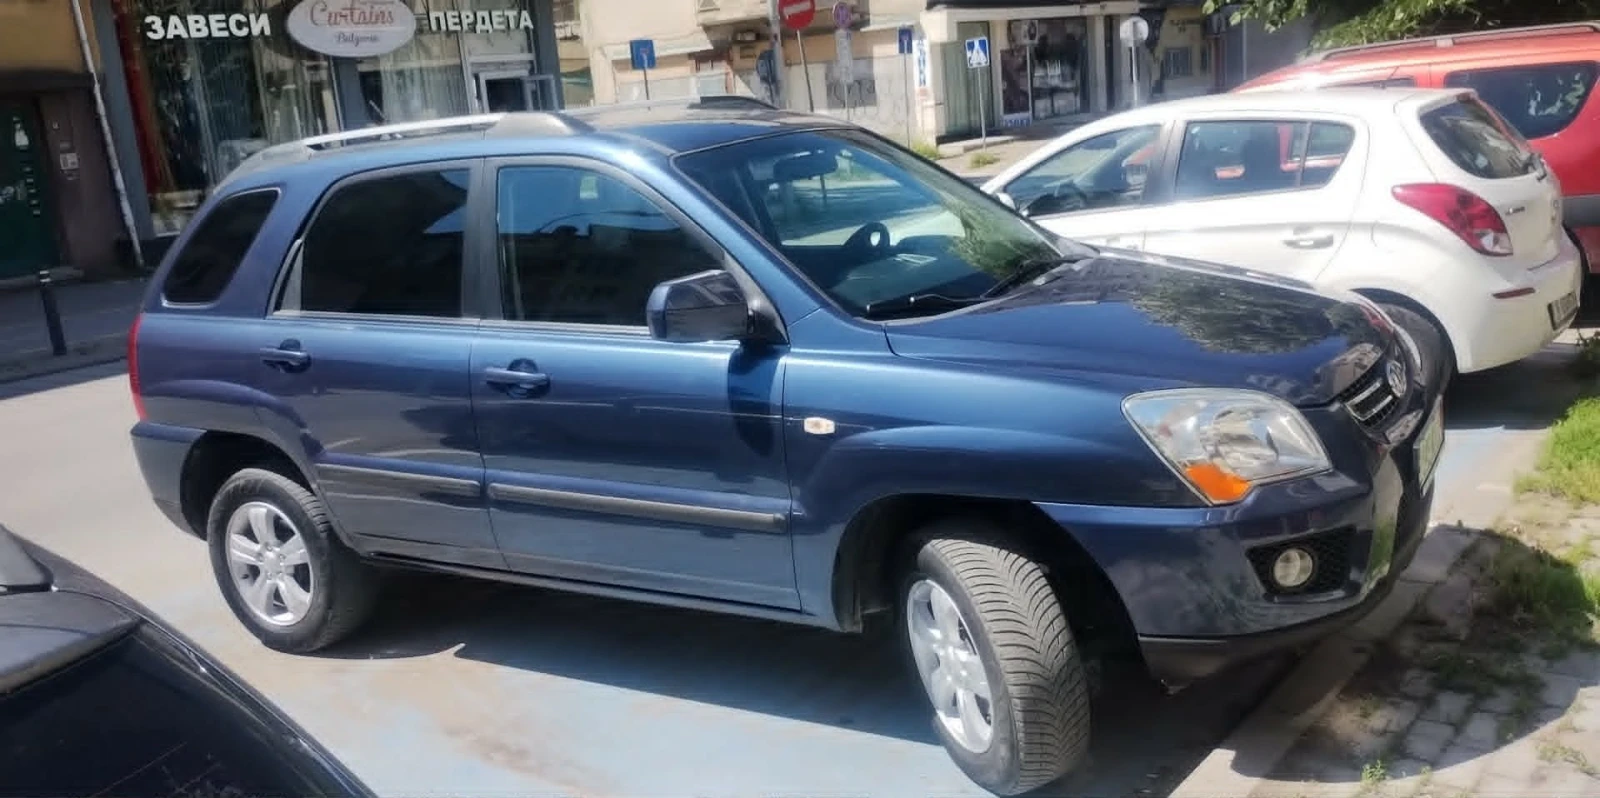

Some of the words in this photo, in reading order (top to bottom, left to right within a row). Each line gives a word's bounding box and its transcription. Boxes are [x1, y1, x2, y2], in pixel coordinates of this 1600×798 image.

[310, 0, 394, 26] Curtains
[428, 10, 534, 34] ПЕРДЕТА
[144, 13, 271, 40] ЗАВЕСИ
